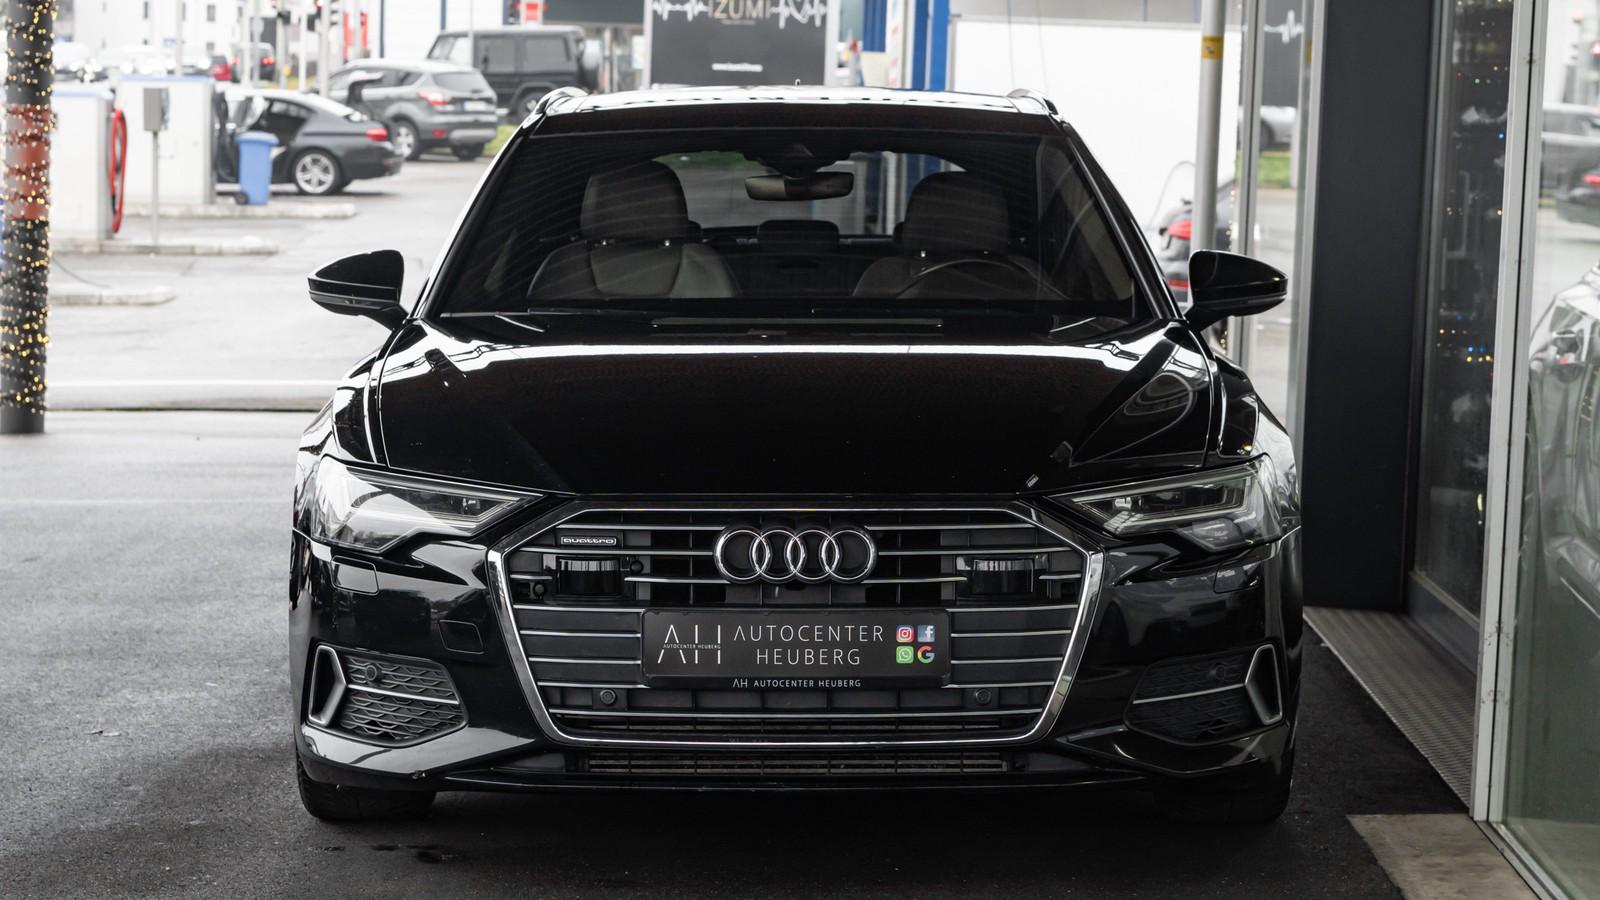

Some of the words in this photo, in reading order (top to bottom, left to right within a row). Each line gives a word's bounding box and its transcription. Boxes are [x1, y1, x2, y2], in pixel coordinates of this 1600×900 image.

[733, 625, 884, 642] AUTOCENTER
[657, 624, 721, 665] AH
[756, 648, 861, 665] HEUBERG
[732, 678, 748, 688] AH
[753, 679, 814, 688] AUTOCENTER
[818, 679, 862, 688] HEUBERG
